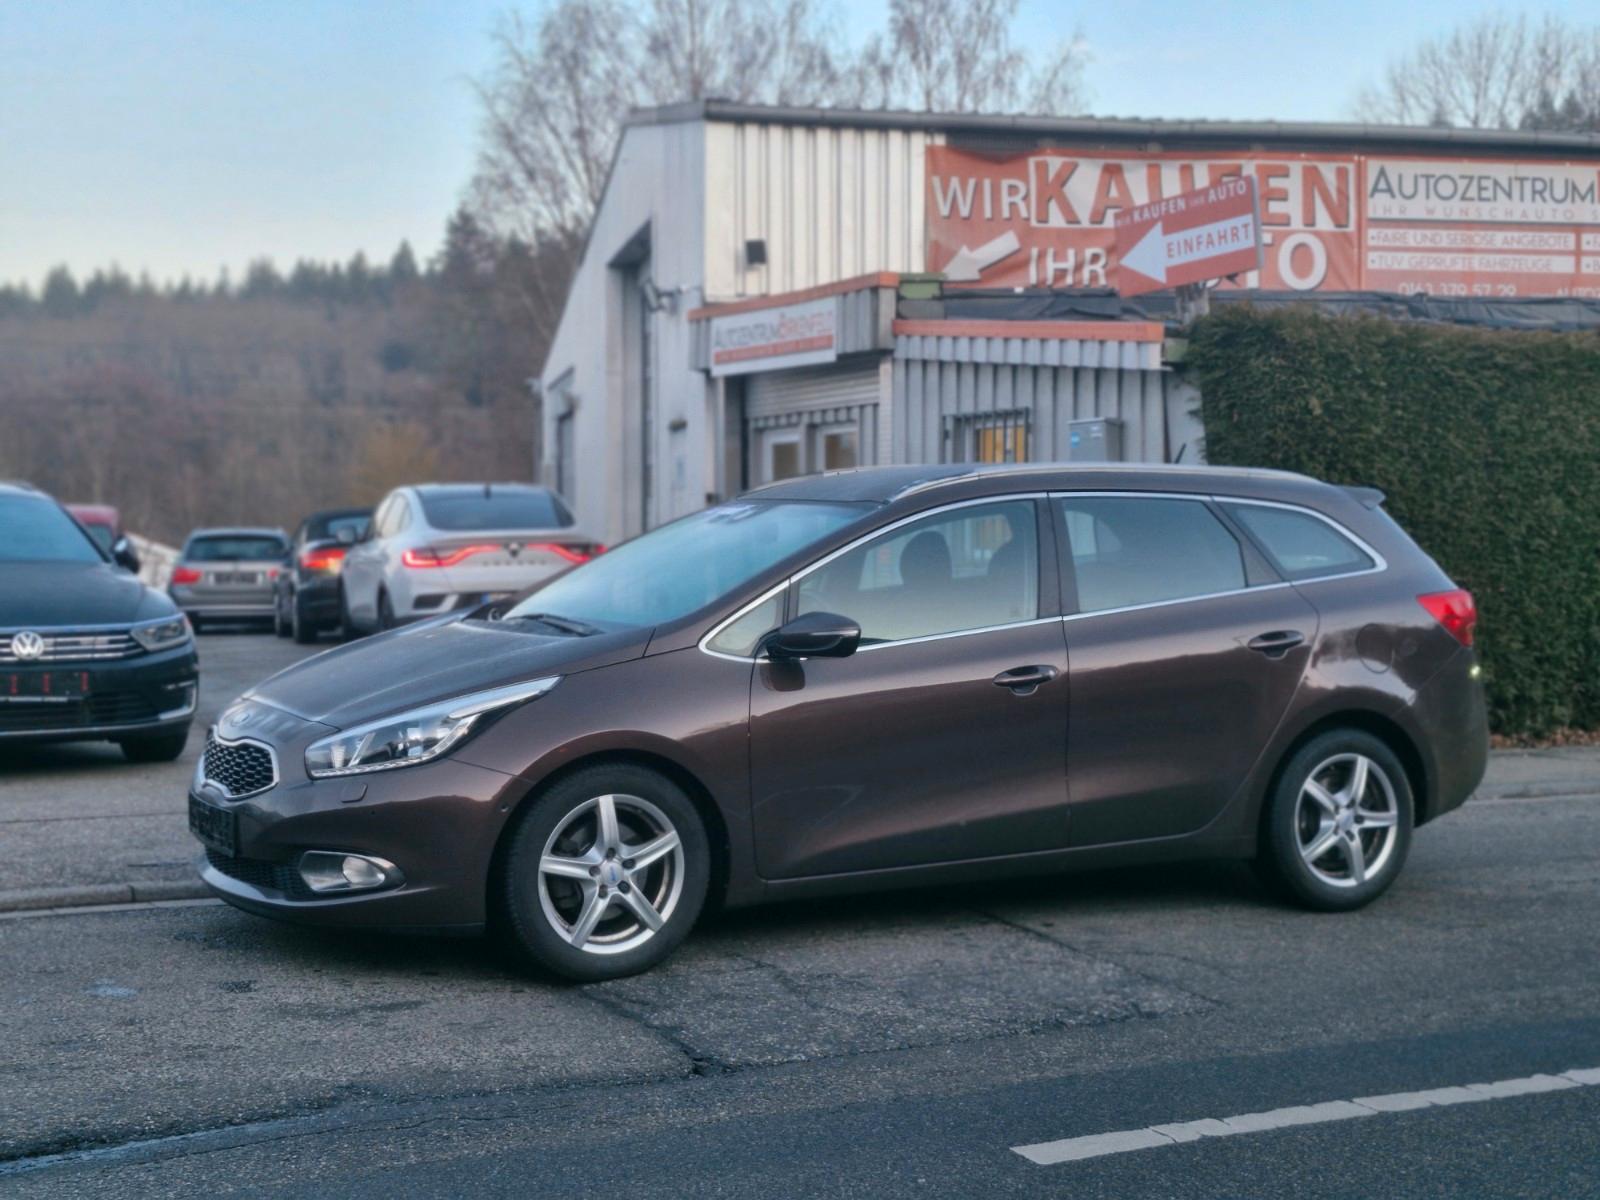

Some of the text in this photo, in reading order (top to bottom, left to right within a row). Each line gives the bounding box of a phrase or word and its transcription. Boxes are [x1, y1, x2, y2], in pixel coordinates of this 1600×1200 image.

[931, 175, 1029, 220] WIR
[1133, 197, 1186, 223] KAUFEN
[1208, 180, 1247, 203] AUTO
[1373, 206, 1407, 217] IHR
[1425, 206, 1575, 220] WUNSCHAUTO
[1166, 223, 1250, 258] EINFAHRT
[1414, 231, 1442, 245] UND
[1030, 247, 1107, 287] IHR
